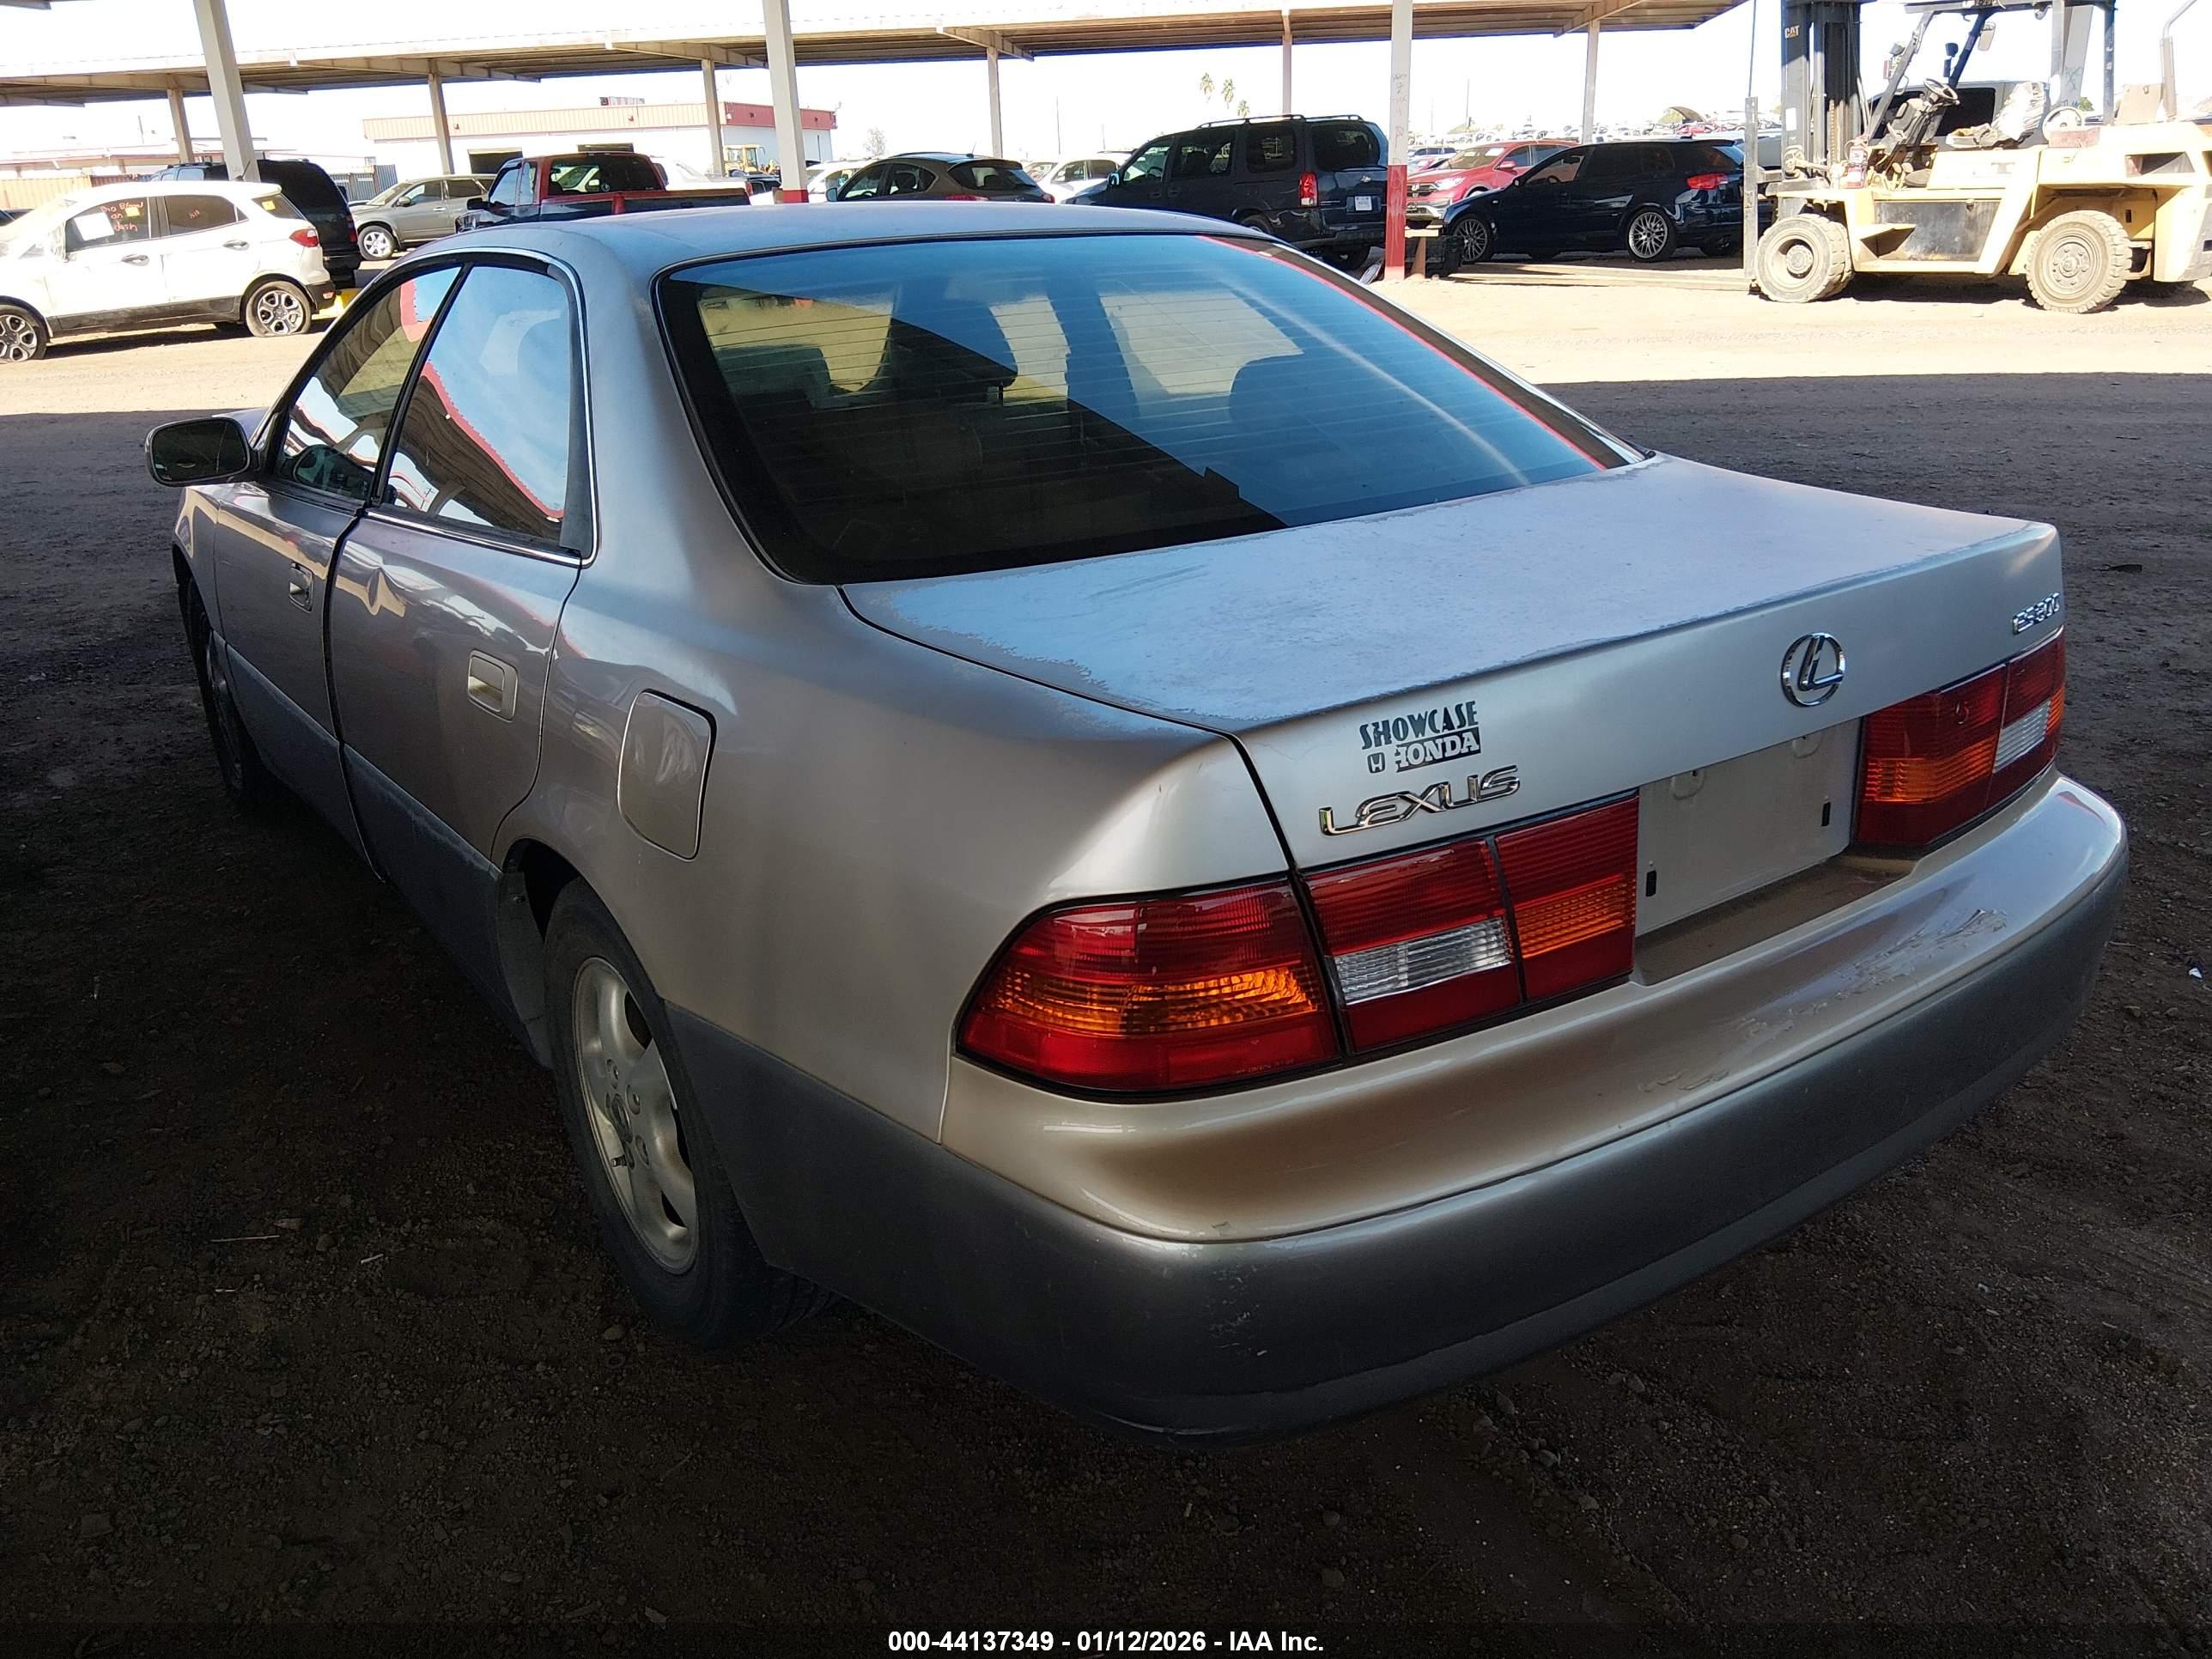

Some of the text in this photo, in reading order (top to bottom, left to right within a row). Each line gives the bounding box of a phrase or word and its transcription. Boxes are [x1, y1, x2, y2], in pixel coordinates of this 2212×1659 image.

[1784, 25, 1801, 40] CAT
[118, 201, 144, 210] Bld
[1359, 700, 1480, 750] SHOWCASE
[1395, 728, 1480, 771] HONDA
[1318, 764, 1521, 836] LEXUS
